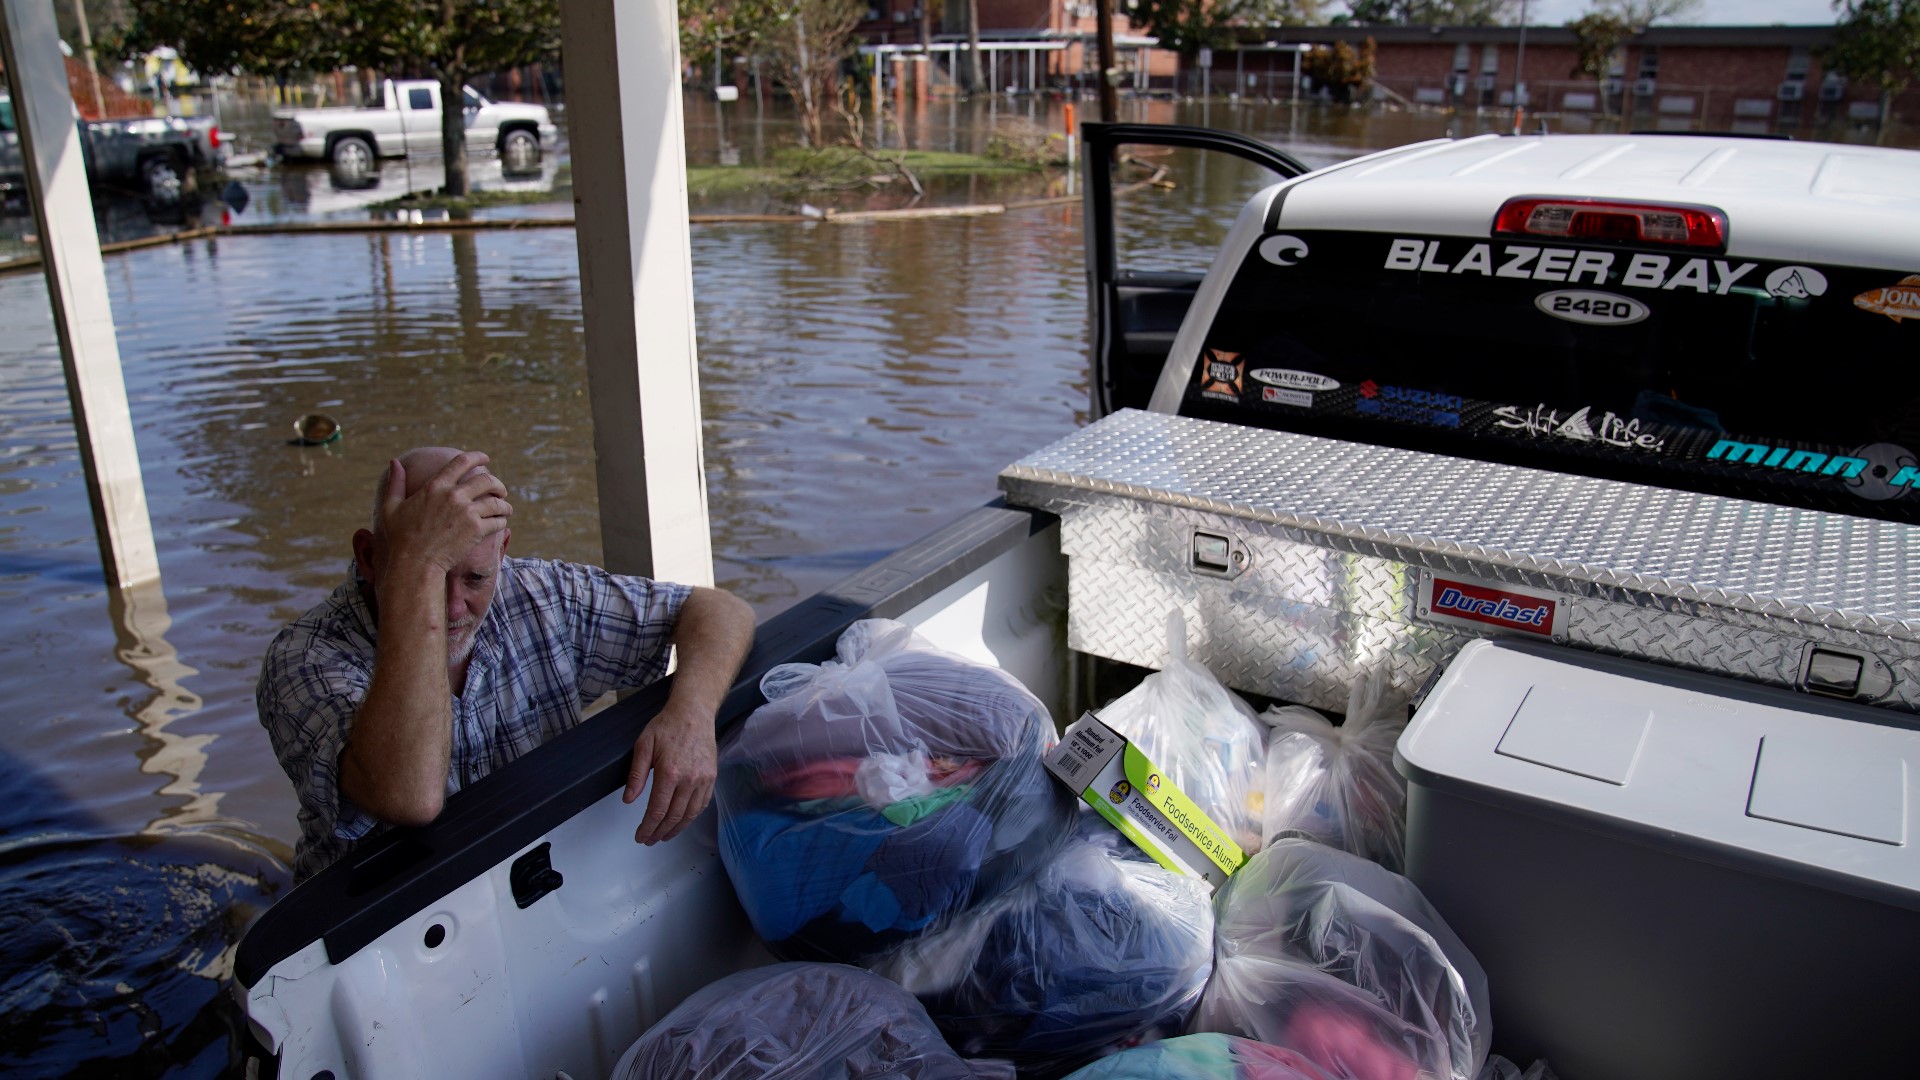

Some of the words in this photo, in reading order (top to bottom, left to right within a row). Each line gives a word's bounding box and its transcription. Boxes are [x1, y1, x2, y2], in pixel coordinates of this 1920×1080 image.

[1384, 238, 1615, 285] BLAZER
[1621, 253, 1759, 295] BAY
[1553, 297, 1631, 320] 2420
[1259, 369, 1328, 386] POWER-POLE
[1383, 385, 1462, 409] SUZUKI
[1436, 587, 1548, 626] Duralast
[1075, 730, 1096, 748] Aluminum
[1093, 744, 1105, 754] Foil
[1085, 726, 1106, 744] Standard
[1131, 797, 1166, 832] Foodservice
[1164, 828, 1179, 842] Foil
[1163, 795, 1213, 850] Foodservice
